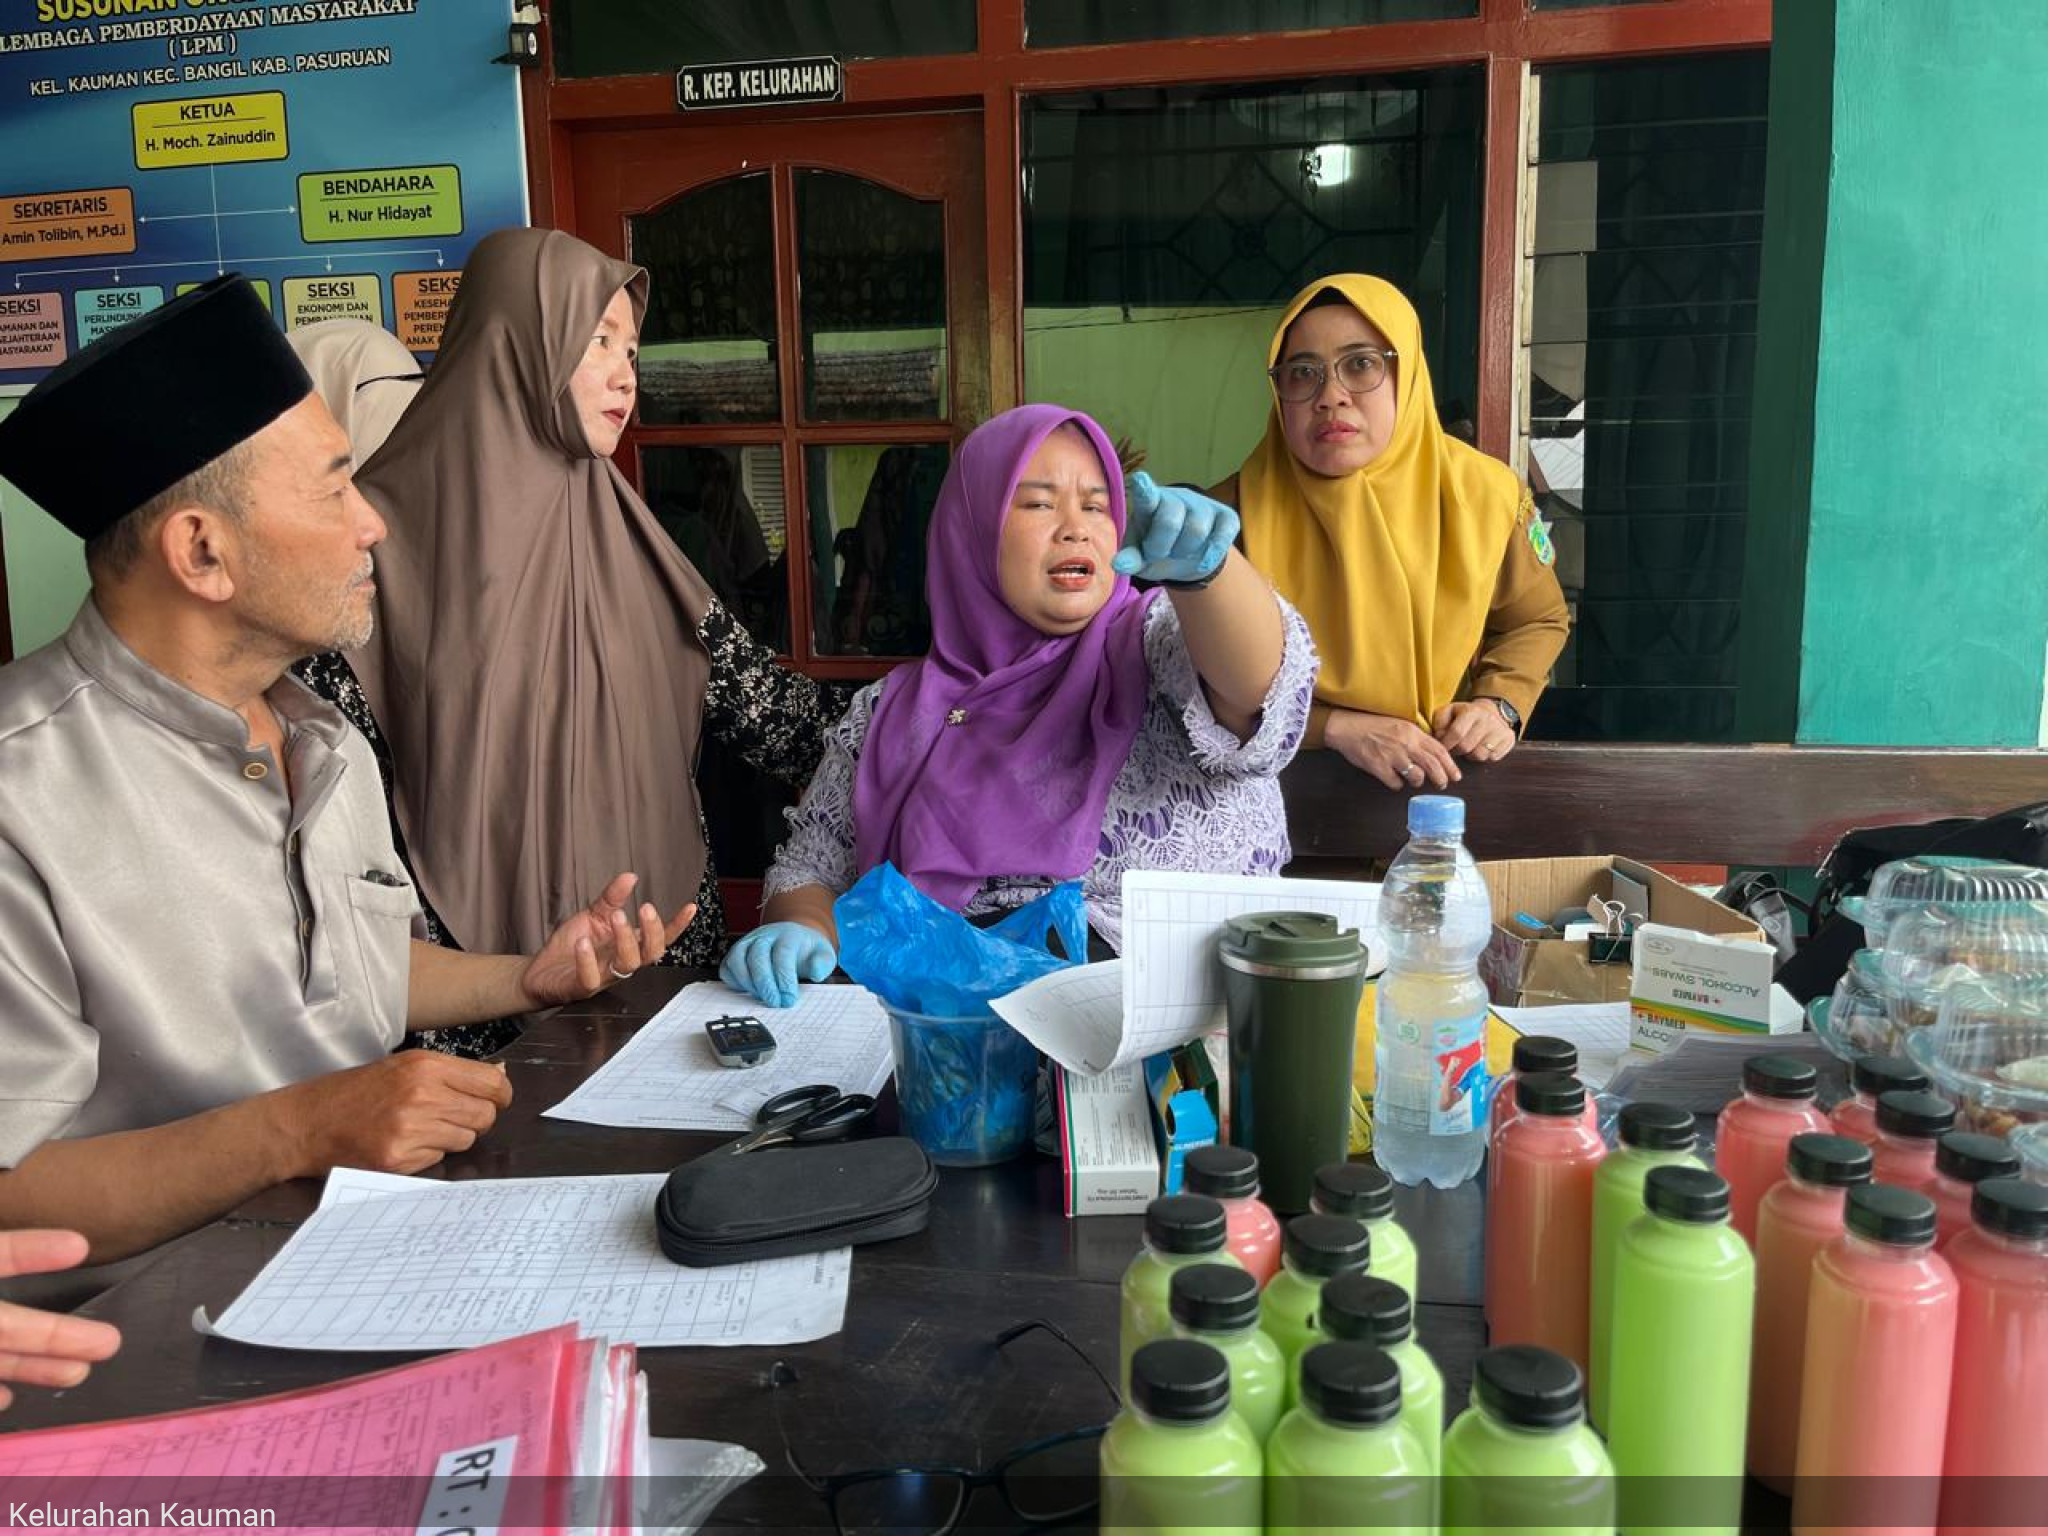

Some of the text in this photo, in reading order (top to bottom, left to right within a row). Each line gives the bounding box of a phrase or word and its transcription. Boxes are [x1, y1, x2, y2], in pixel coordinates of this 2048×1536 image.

[0, 0, 415, 53] LEMBAGA PEMBERDAYAAN MASYARAKAT
[181, 36, 224, 56] LPM
[30, 49, 391, 96] KEL. KAUMAN KEC. BANGIL KAB. PASURUAN
[684, 64, 835, 101] R. KEP. KELURAHAN
[180, 102, 236, 121] KETUA
[145, 129, 276, 151] H. Moch. Zainuddin
[322, 175, 435, 196] BENDAHARA
[13, 196, 109, 219] SEKRETARIS
[328, 204, 434, 224] H. Nur Hidayat
[2, 231, 35, 245] Amin
[97, 293, 141, 308] SEKSI
[307, 282, 355, 299] SEKSI
[0, 299, 41, 315] SEKSI
[297, 301, 369, 314] EKONOMI DAN
[39, 320, 58, 330] DAN
[406, 335, 435, 346] ANAK
[1699, 977, 1760, 998] ALCOHOL
[446, 1447, 497, 1493] RT
